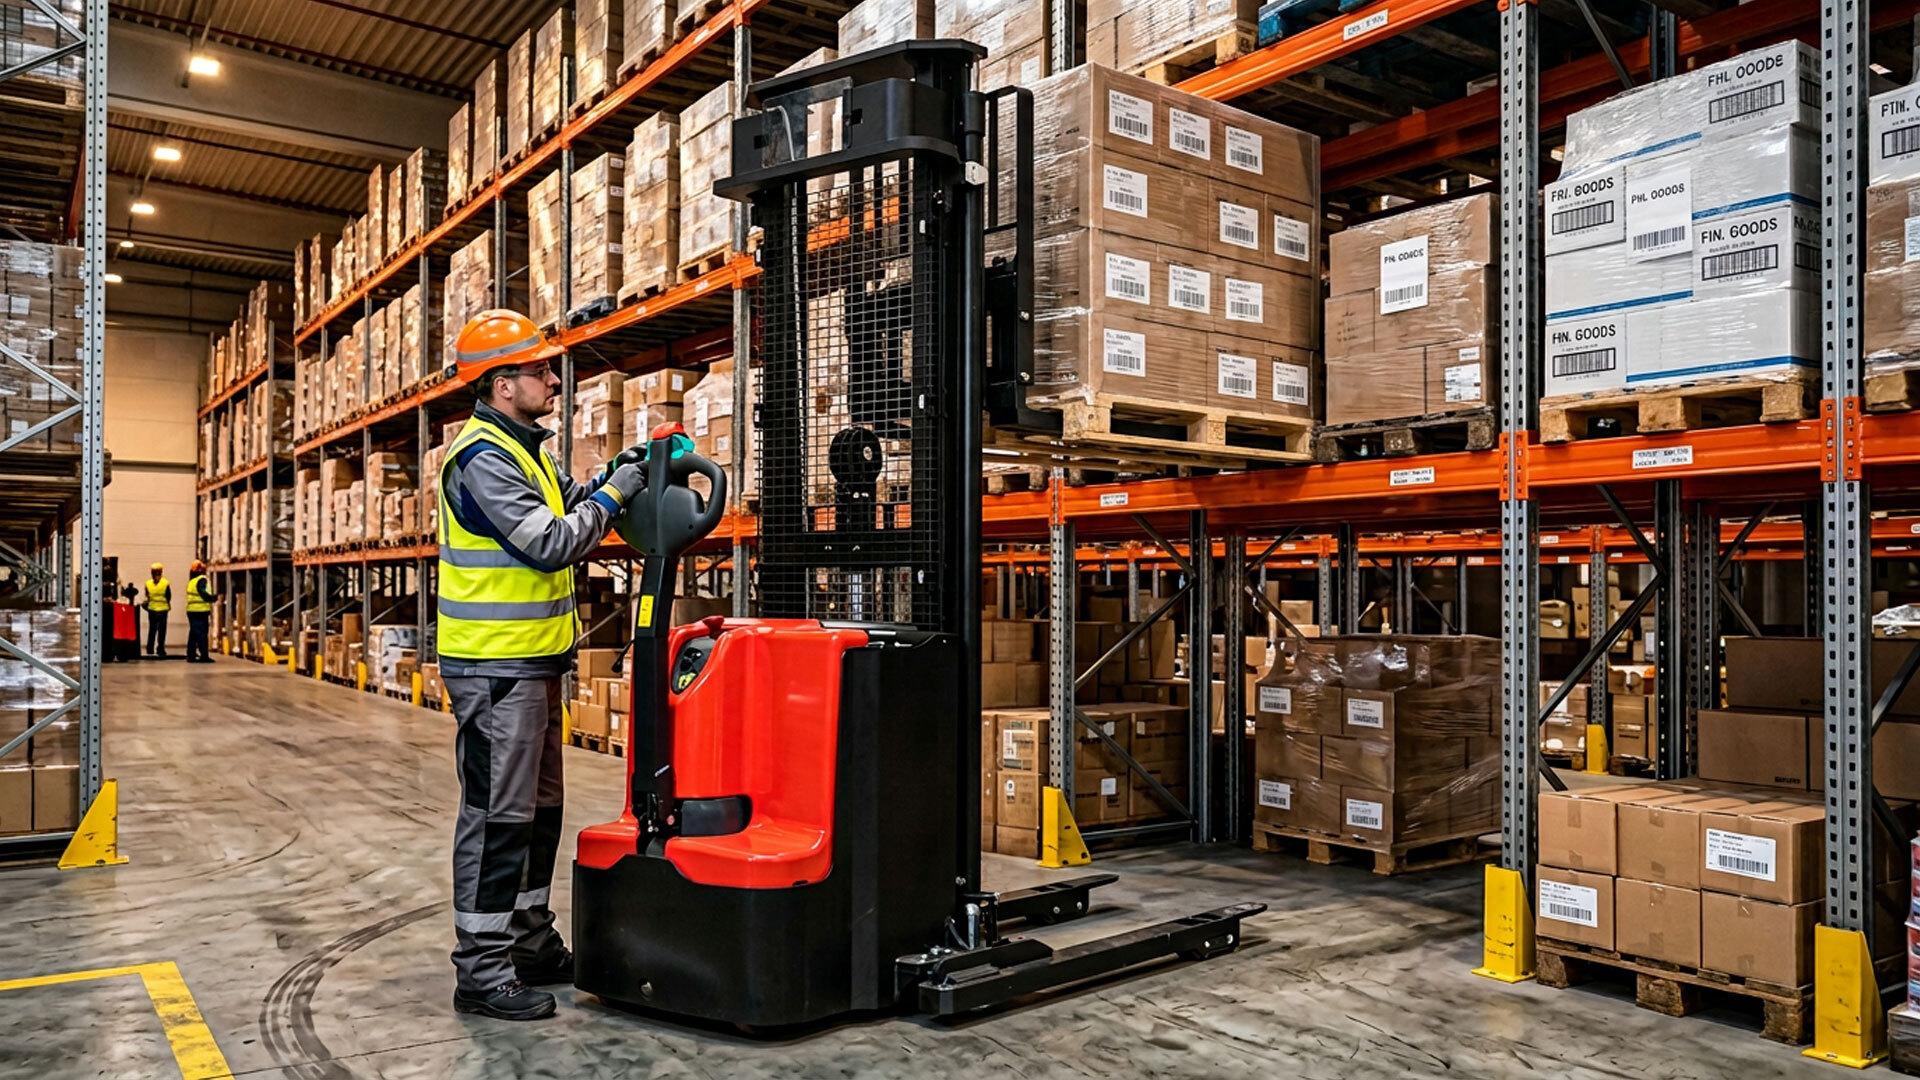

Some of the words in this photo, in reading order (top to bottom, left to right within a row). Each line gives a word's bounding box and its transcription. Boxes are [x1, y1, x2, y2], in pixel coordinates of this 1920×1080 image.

[1701, 228, 1725, 244] FIN.
[1730, 217, 1778, 238] GOODS
[1575, 324, 1616, 341] GOODS
